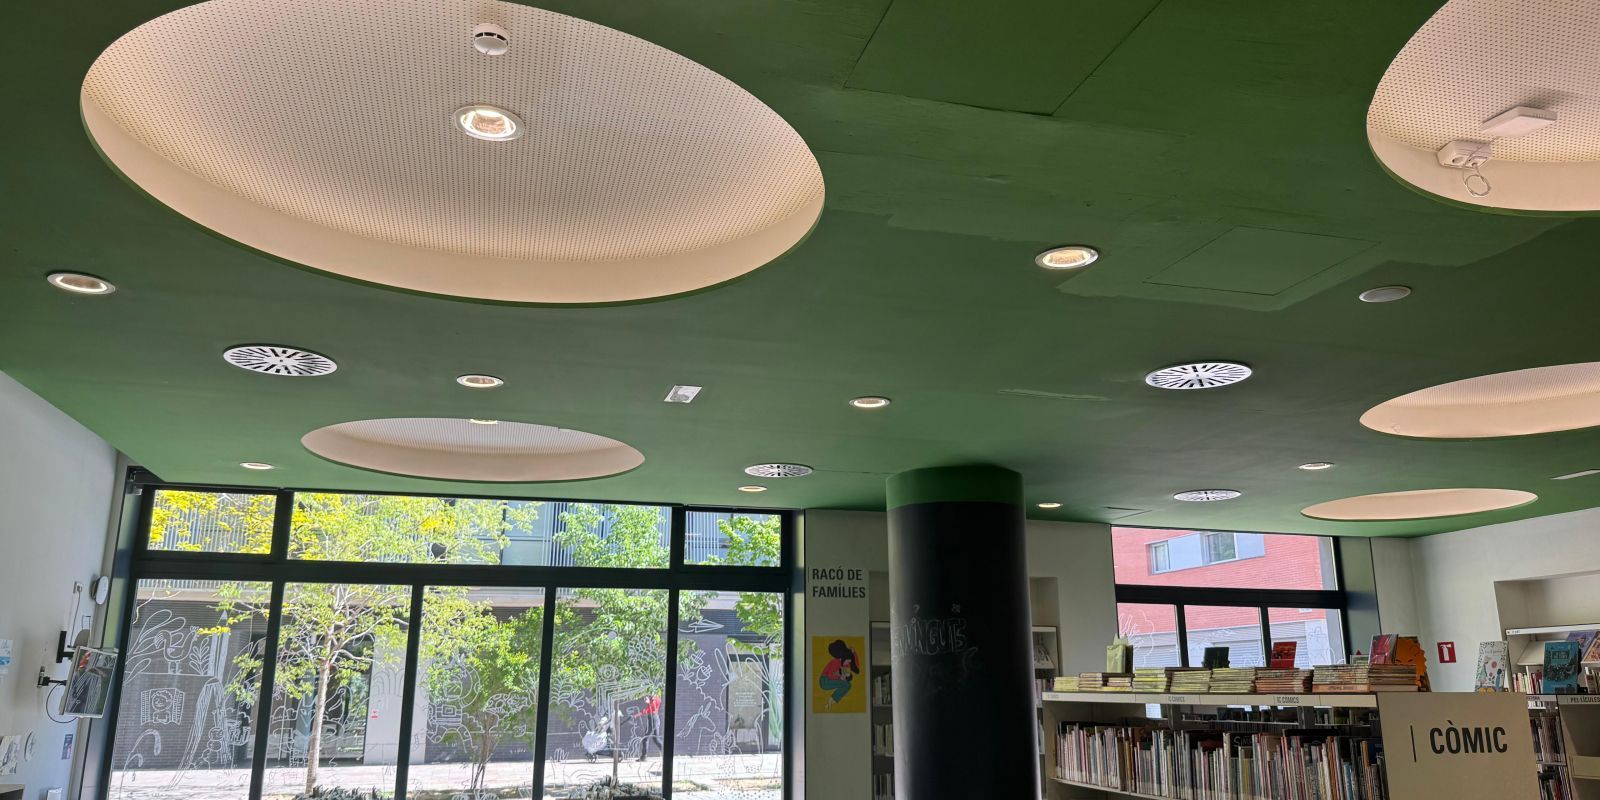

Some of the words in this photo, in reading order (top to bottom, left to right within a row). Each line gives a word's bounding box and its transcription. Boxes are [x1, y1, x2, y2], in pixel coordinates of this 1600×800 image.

[812, 565, 844, 581] RACÓ
[847, 569, 863, 581] DE
[812, 583, 866, 598] FAMÍLIES
[1429, 719, 1508, 754] CÒMIC
